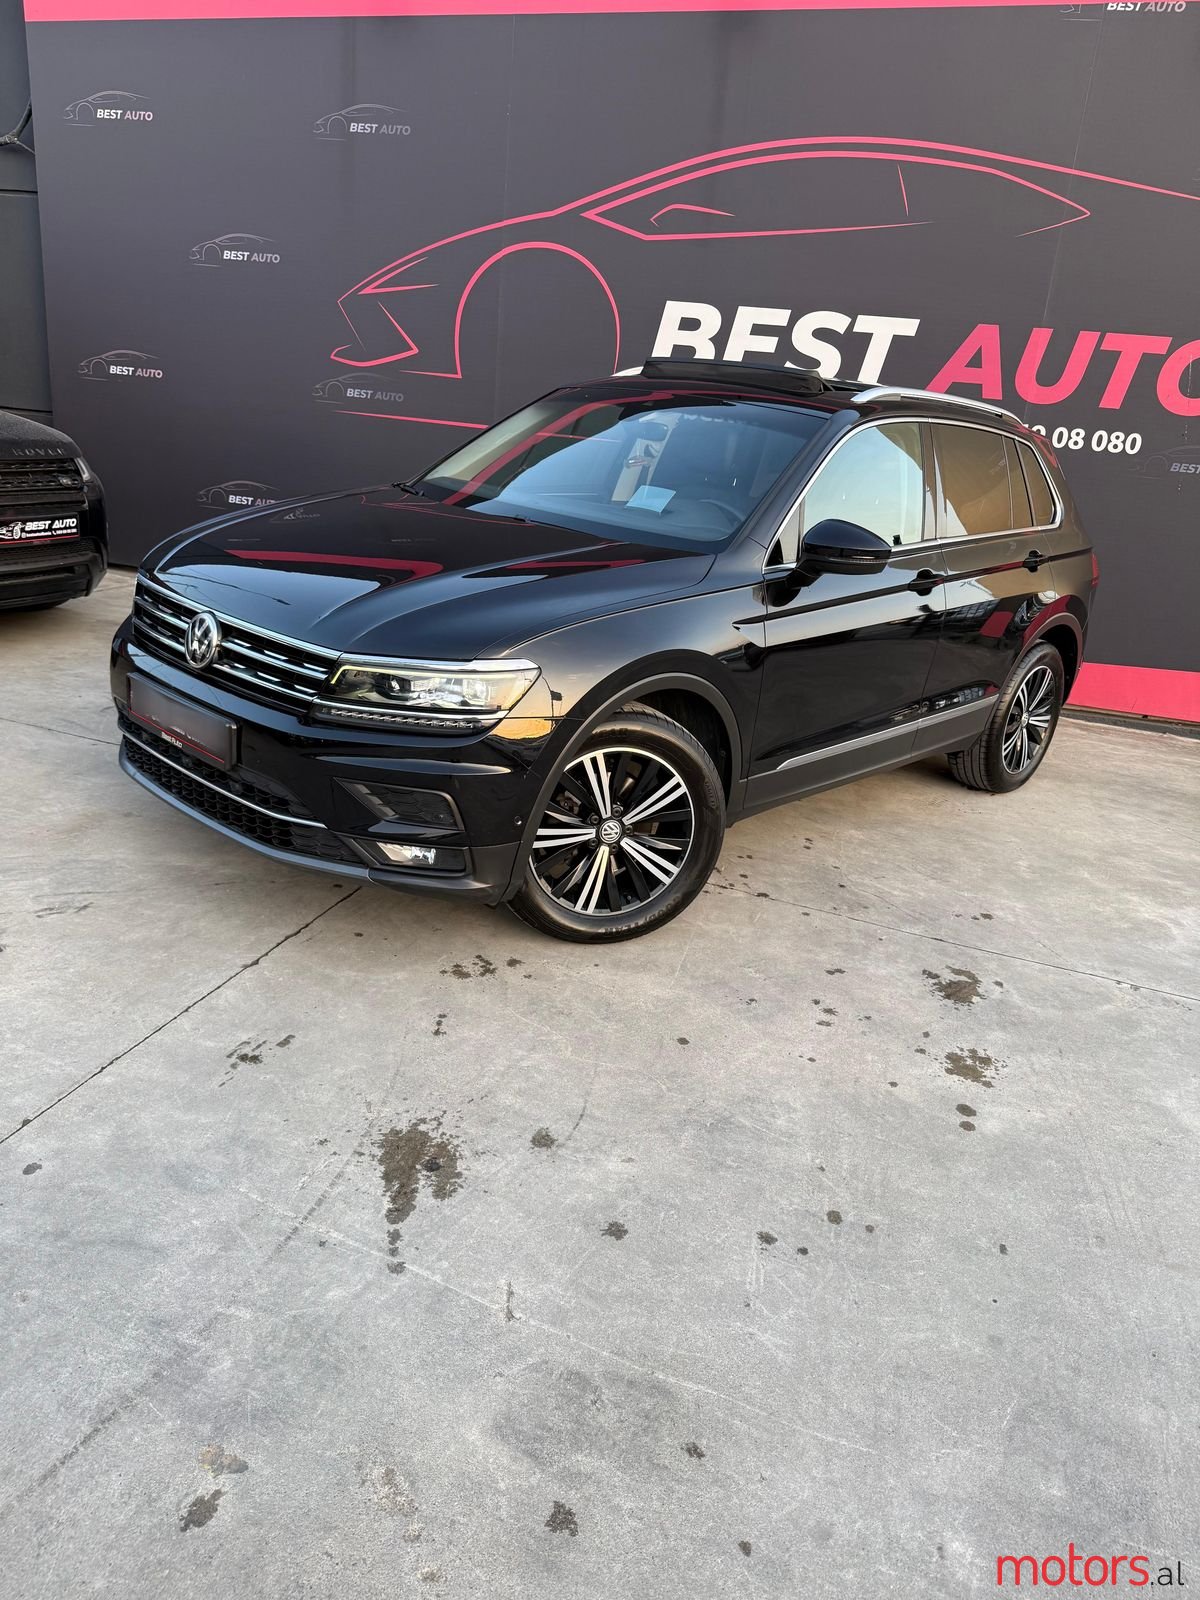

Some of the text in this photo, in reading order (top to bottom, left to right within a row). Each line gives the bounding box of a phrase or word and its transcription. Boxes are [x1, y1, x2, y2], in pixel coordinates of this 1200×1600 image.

[96, 109, 153, 121] BEST AUTO
[349, 123, 411, 135] BEST AUTO
[223, 251, 280, 263] BEST AUTO
[651, 300, 1200, 417] BEST AUTO
[109, 365, 163, 378] BEST AUTO
[346, 388, 404, 402] BEST AUTO
[1052, 426, 1086, 450] 08
[1091, 430, 1142, 455] 080
[1170, 462, 1200, 474] BEST
[228, 494, 254, 506] BEST
[25, 518, 77, 531] BEST AUTO
